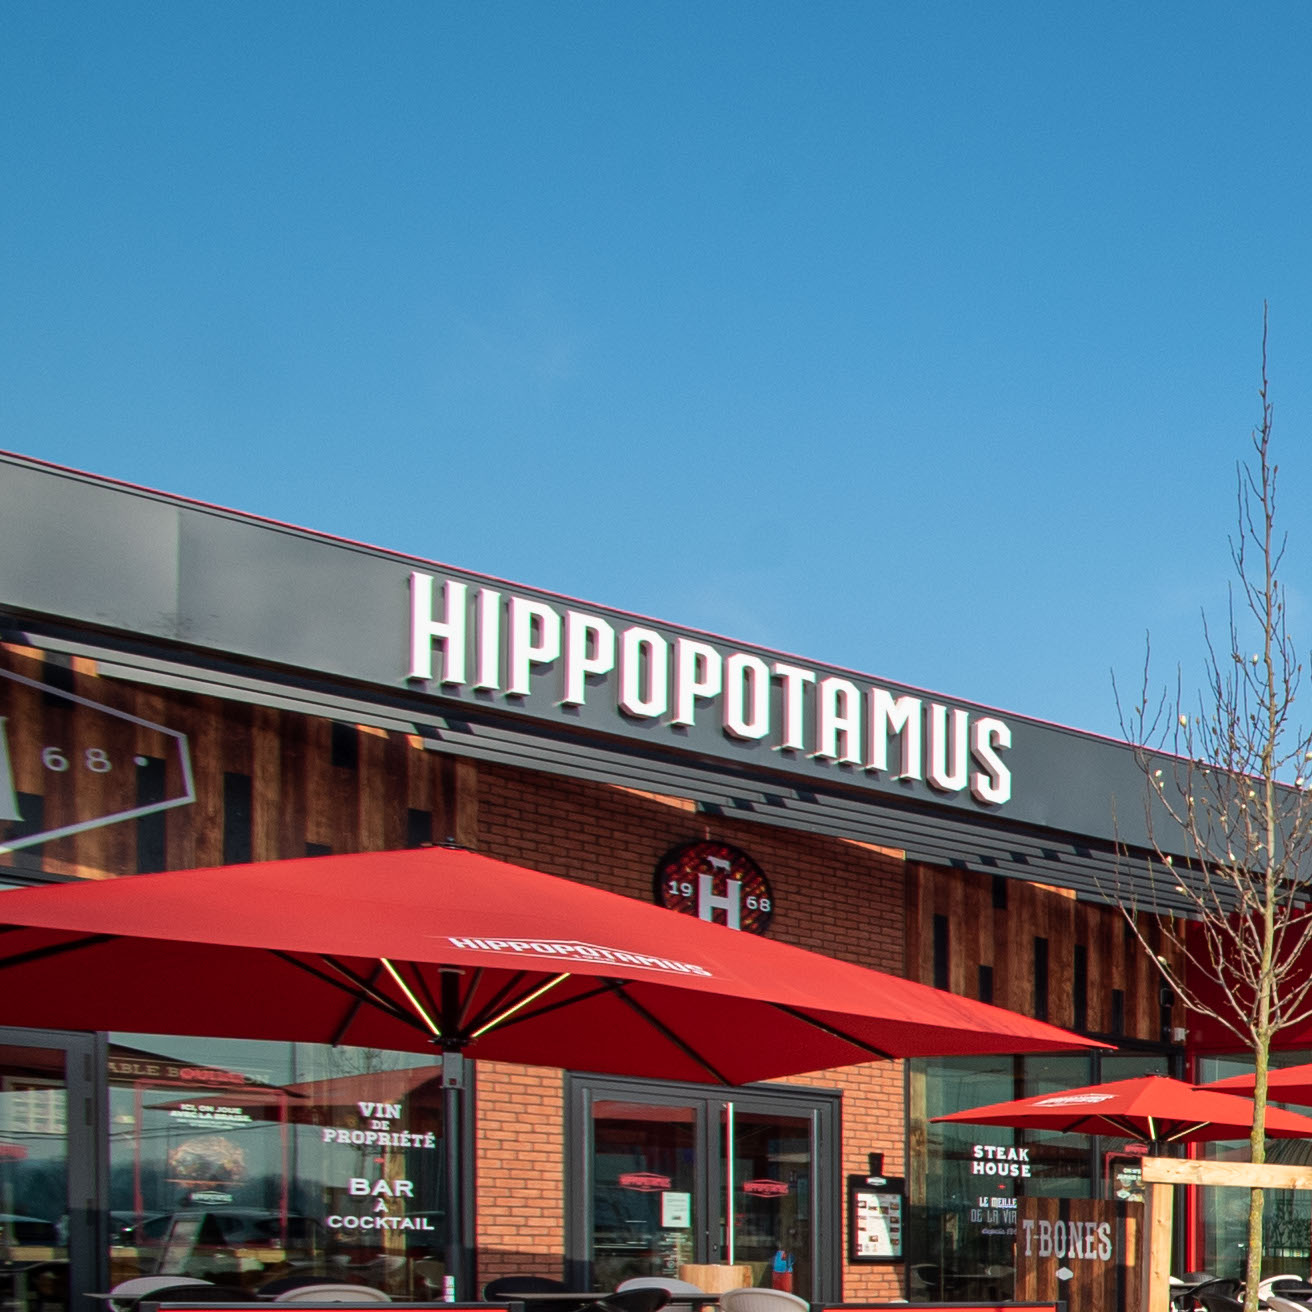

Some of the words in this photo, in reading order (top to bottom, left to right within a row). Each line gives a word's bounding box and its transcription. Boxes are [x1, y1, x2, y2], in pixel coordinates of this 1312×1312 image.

[408, 571, 1012, 805] HIPPOPOTAMUS
[42, 746, 112, 773] 68
[668, 880, 693, 897] 19
[698, 873, 742, 931] H
[746, 896, 771, 912] 68
[449, 937, 713, 977] HIPPOPOTAMUS
[358, 1101, 402, 1119] VIN
[369, 1120, 390, 1130] DE
[322, 1129, 436, 1149] PROPRIÉTÉ
[973, 1145, 1030, 1161] STEAK
[972, 1161, 1032, 1178] HOUSE
[348, 1177, 414, 1198] BAR
[979, 1196, 989, 1208] LE
[326, 1215, 435, 1231] COCKTAIL
[970, 1208, 982, 1223] DE
[987, 1209, 999, 1224] LA
[1022, 1219, 1112, 1261] T-BONES
